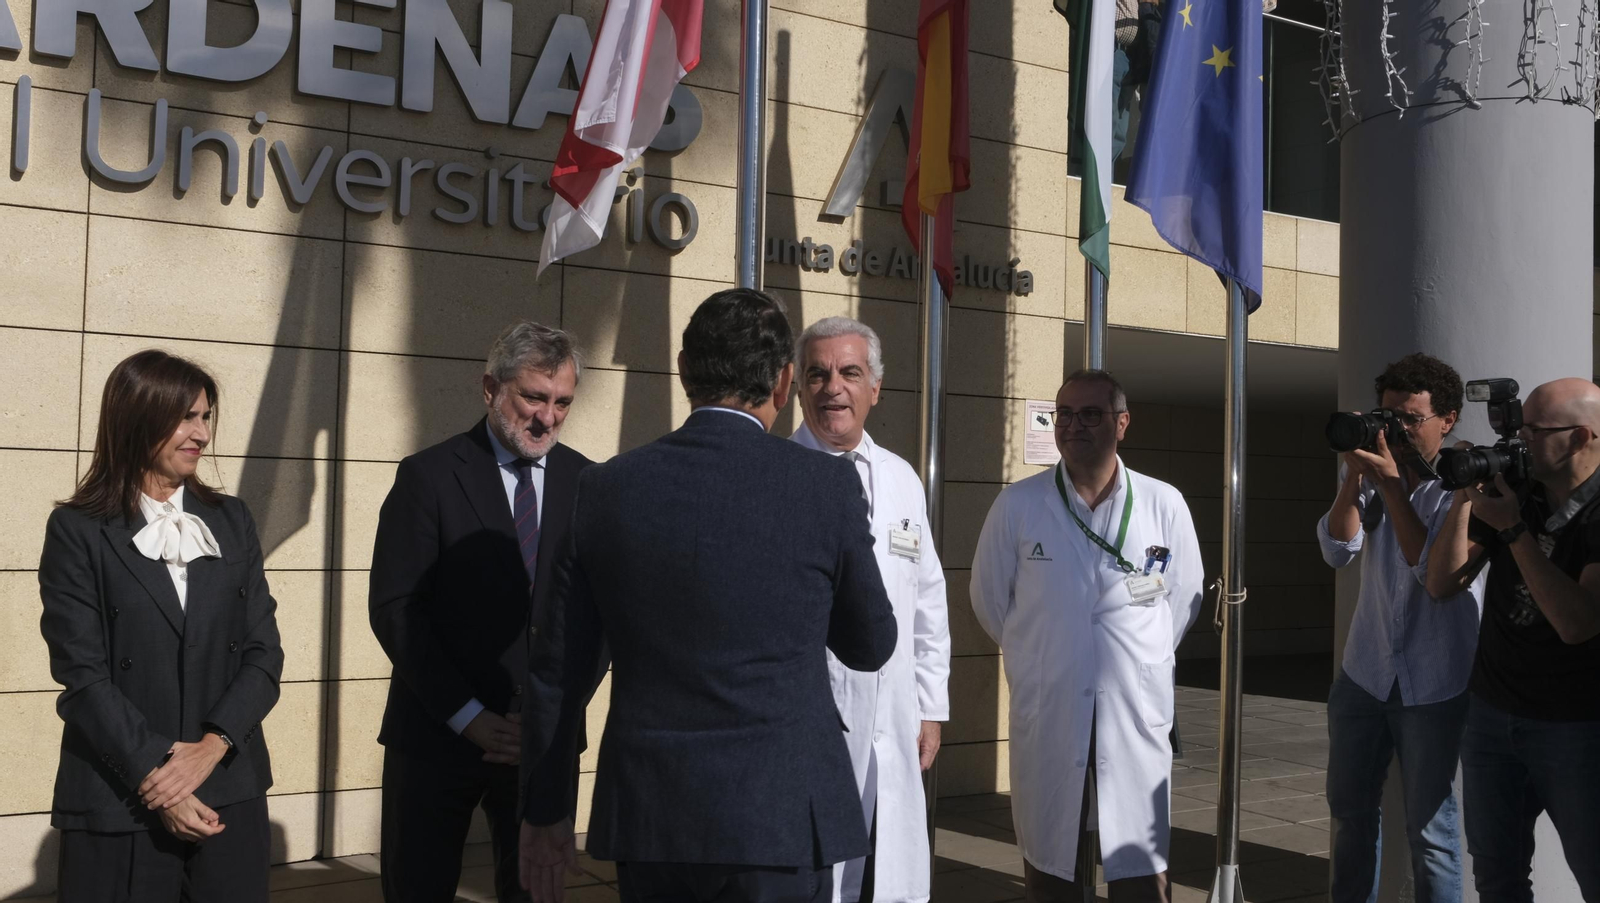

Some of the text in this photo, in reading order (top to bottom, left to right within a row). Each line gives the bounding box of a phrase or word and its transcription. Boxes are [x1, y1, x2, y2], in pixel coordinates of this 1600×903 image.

[0, 0, 703, 151] RDENA
[86, 88, 699, 249] Universitio
[764, 236, 1034, 293] unta de Aalucía
